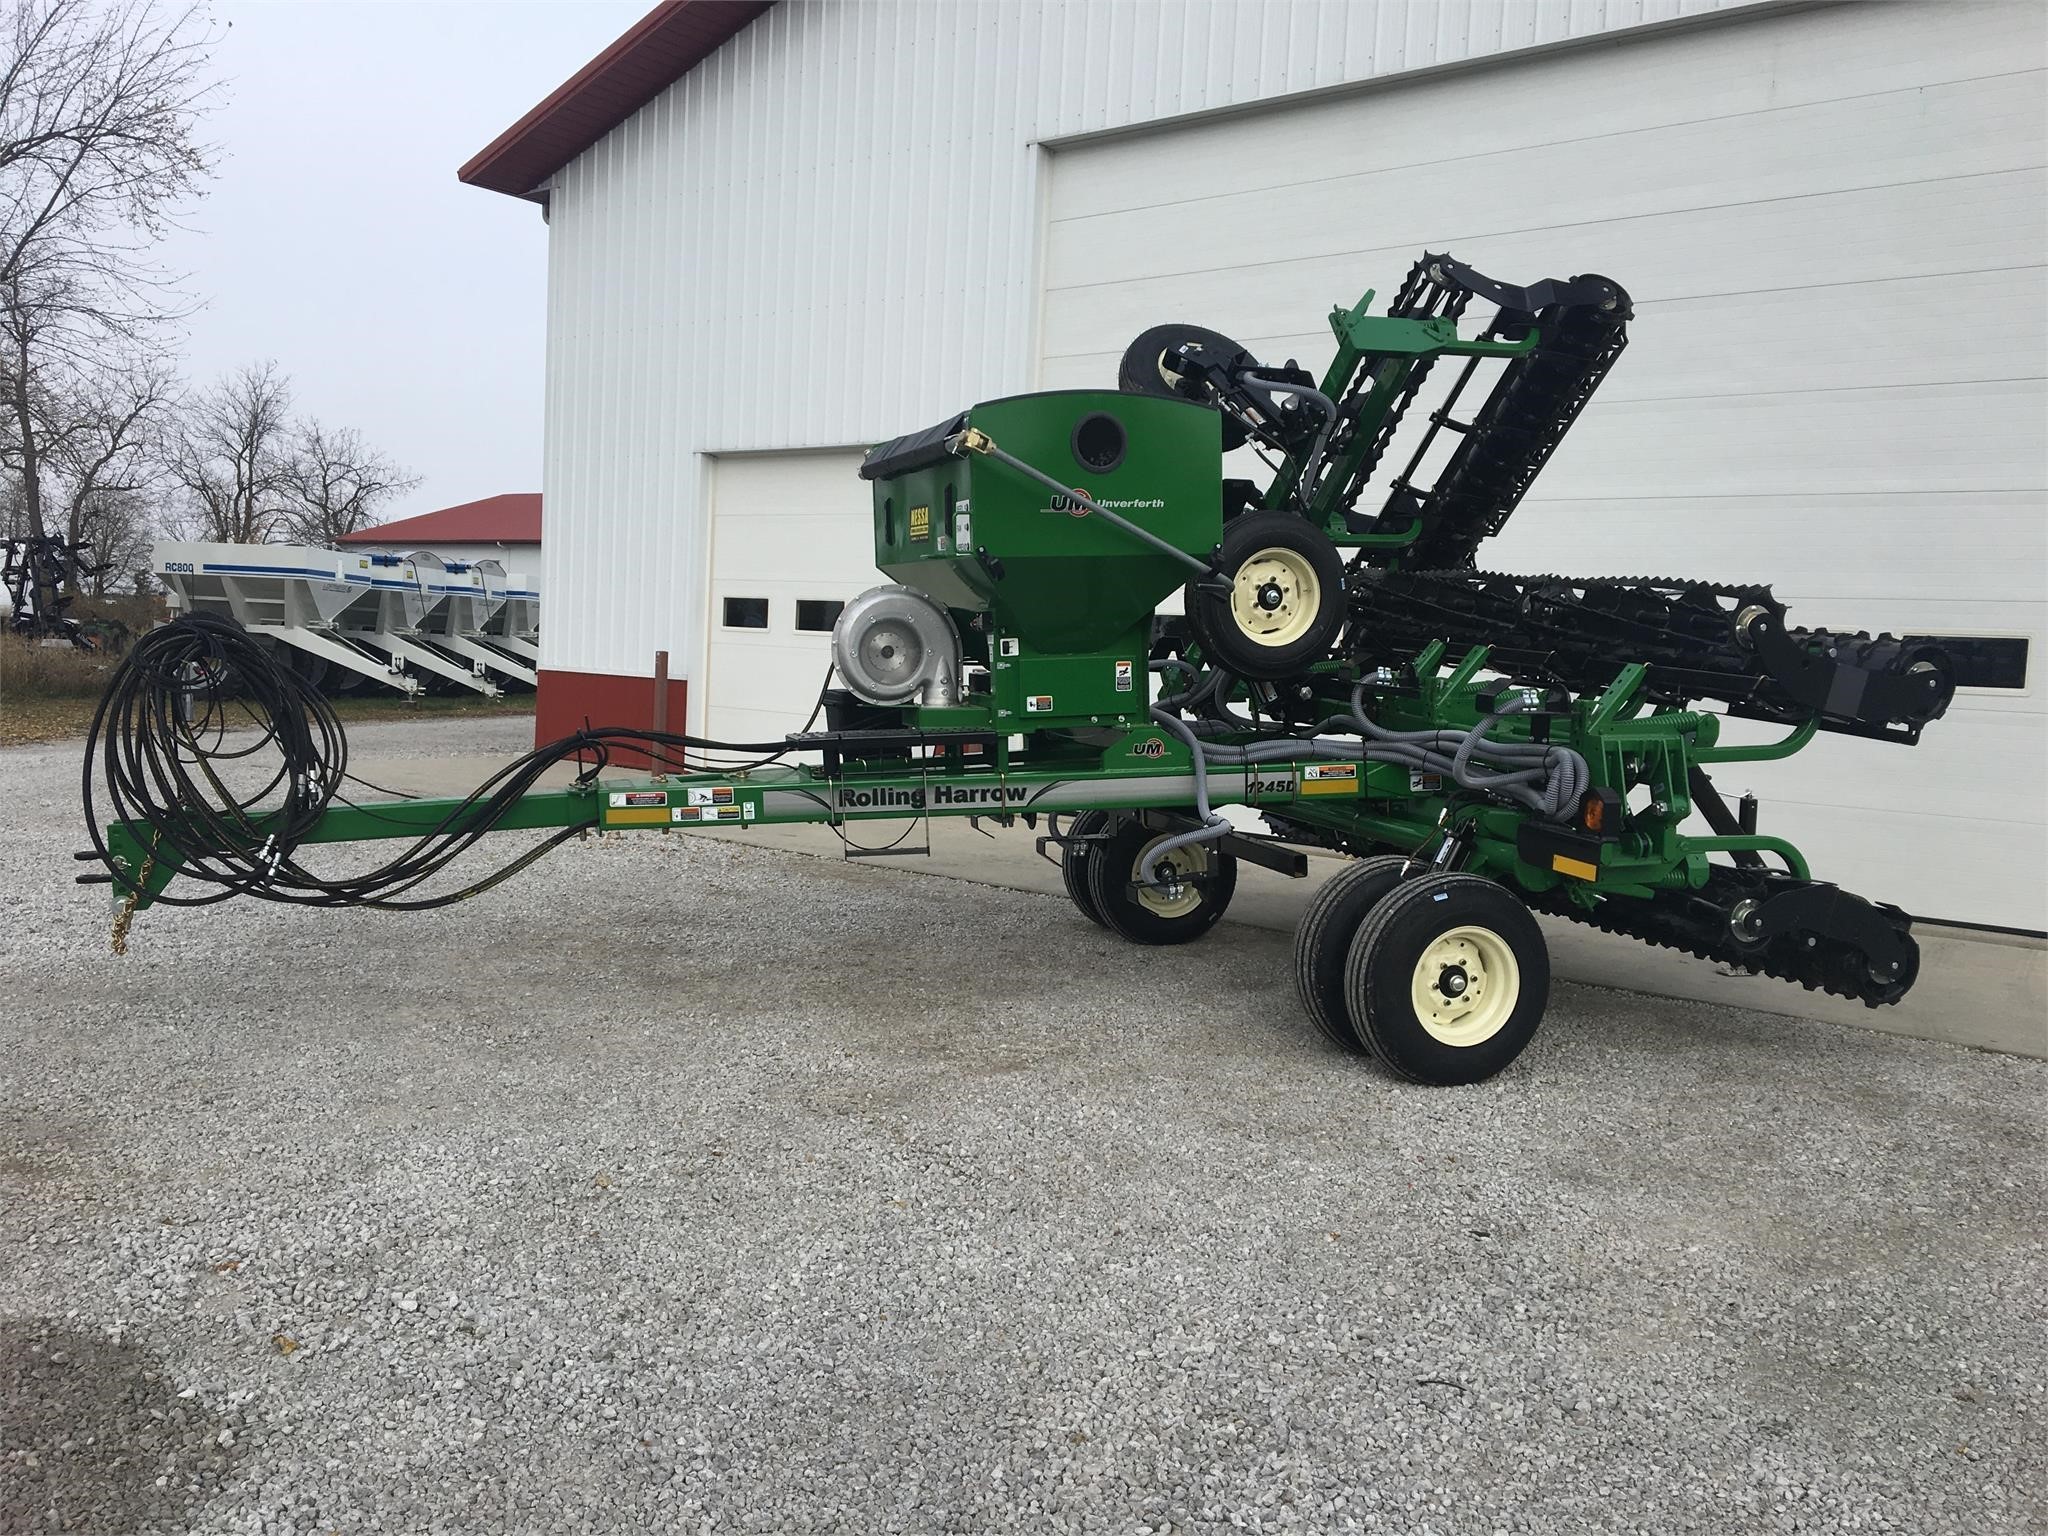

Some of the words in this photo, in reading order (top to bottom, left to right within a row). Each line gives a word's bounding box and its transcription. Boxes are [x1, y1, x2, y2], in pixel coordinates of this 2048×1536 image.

[1096, 499, 1164, 508] Unverferth
[165, 562, 194, 572] RC800
[1133, 743, 1163, 756] UM
[1247, 780, 1297, 794] 1245D
[838, 787, 926, 809] Rolling
[934, 785, 1027, 804] Harrow
